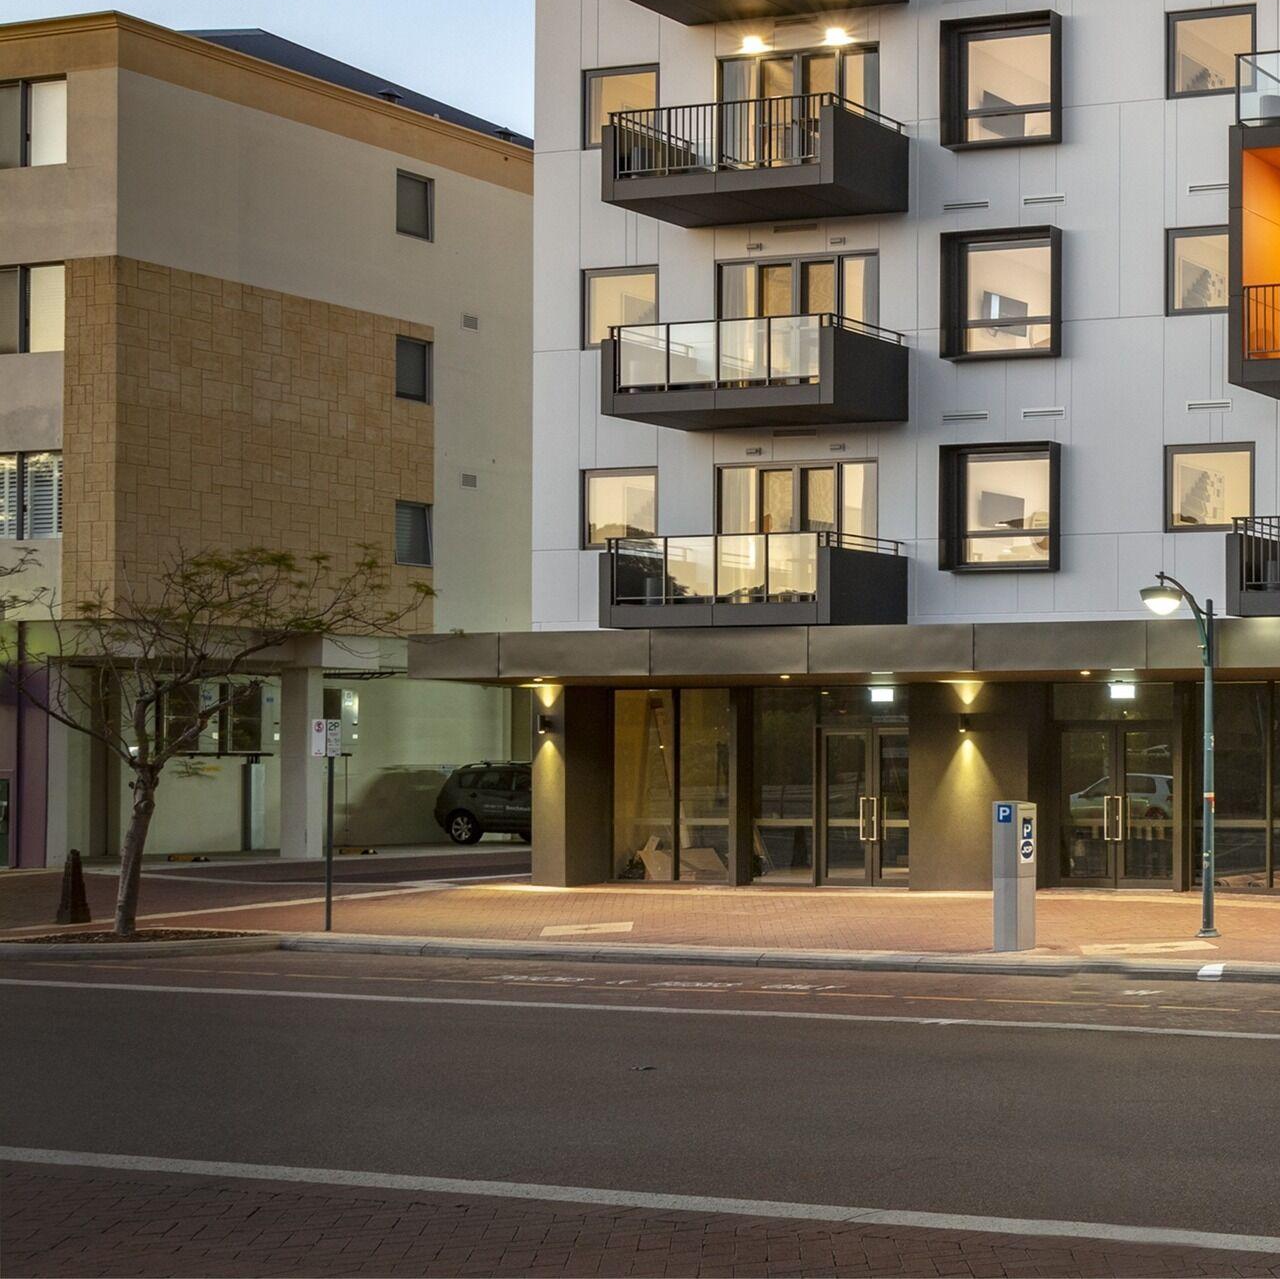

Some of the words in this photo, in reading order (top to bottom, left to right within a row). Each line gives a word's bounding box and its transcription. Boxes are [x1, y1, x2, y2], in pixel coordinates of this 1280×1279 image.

[328, 721, 339, 731] 2P
[1000, 807, 1010, 820] P
[1024, 824, 1032, 837] P
